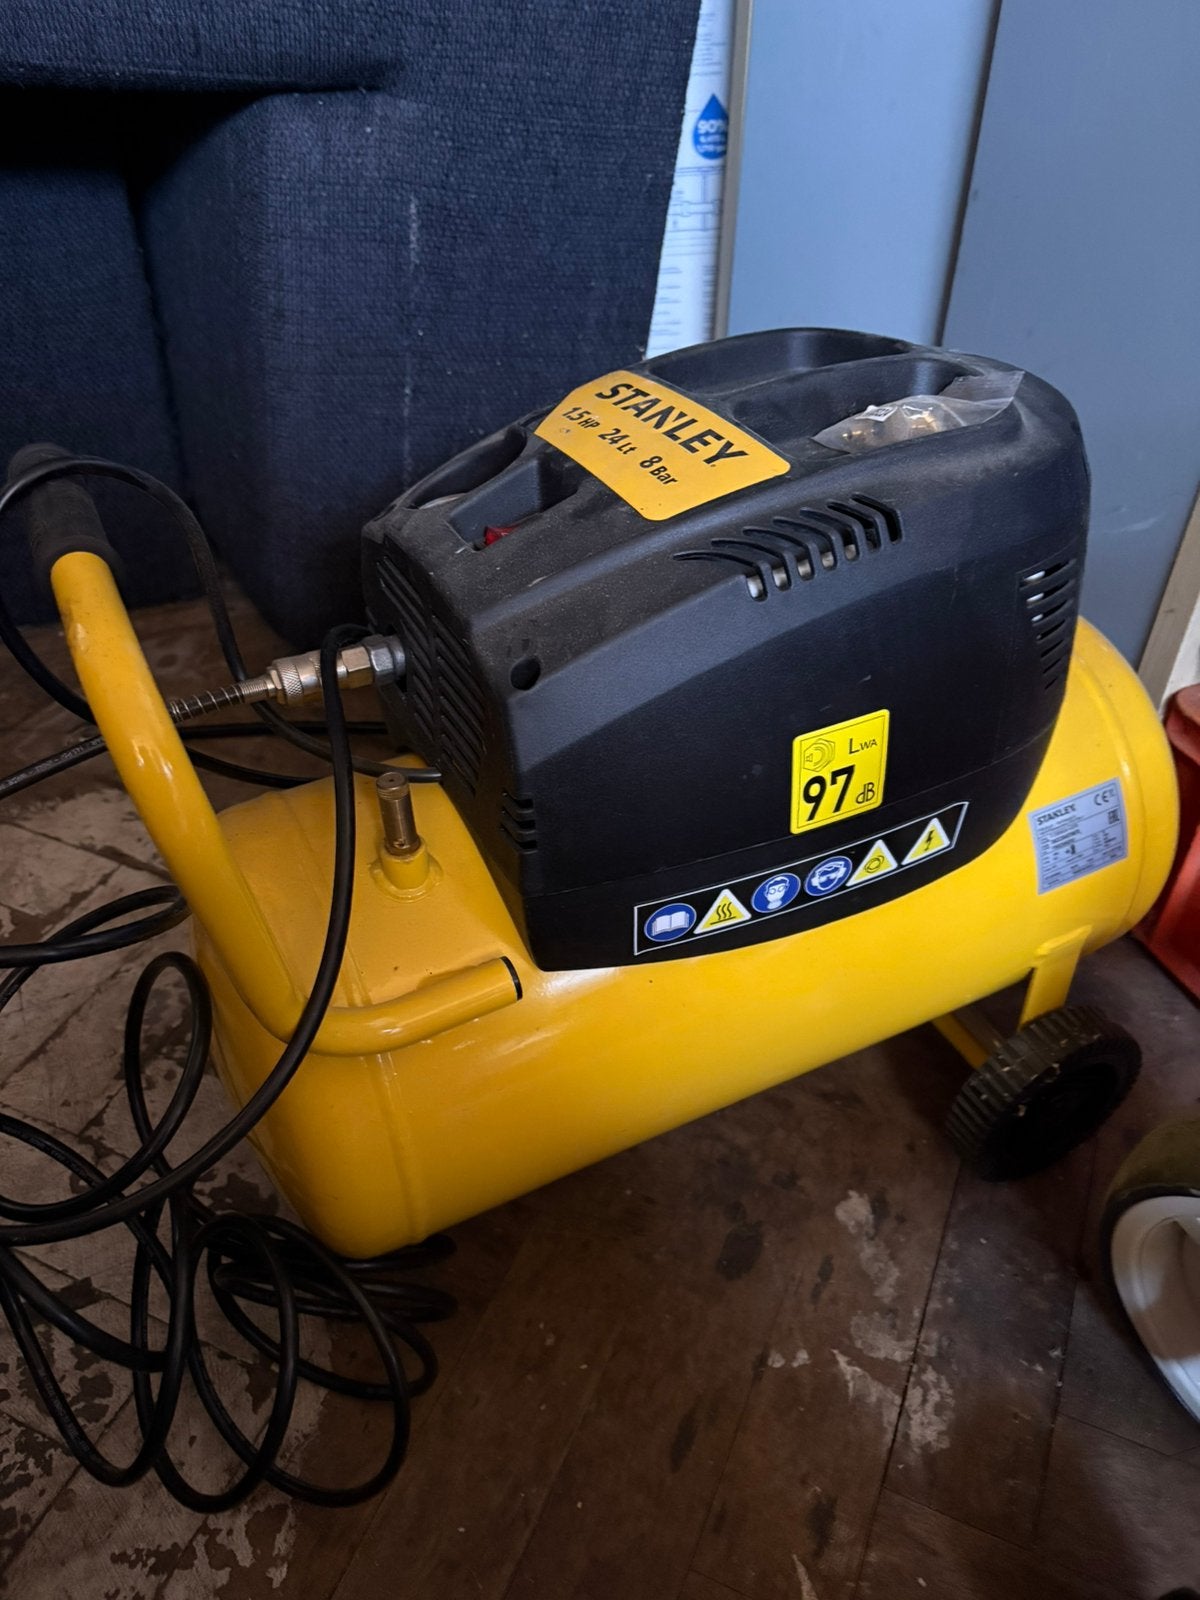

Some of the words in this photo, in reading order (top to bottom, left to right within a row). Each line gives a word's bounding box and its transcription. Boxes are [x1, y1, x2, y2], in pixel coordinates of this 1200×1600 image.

[577, 418, 601, 429] HP
[595, 382, 749, 466] STANLEY
[598, 428, 629, 445] 24
[616, 442, 638, 455] Lt
[639, 455, 663, 469] 8
[649, 466, 678, 485] Bar
[802, 764, 856, 822] 97
[855, 782, 875, 805] dB
[1037, 803, 1077, 825] STANLEY
